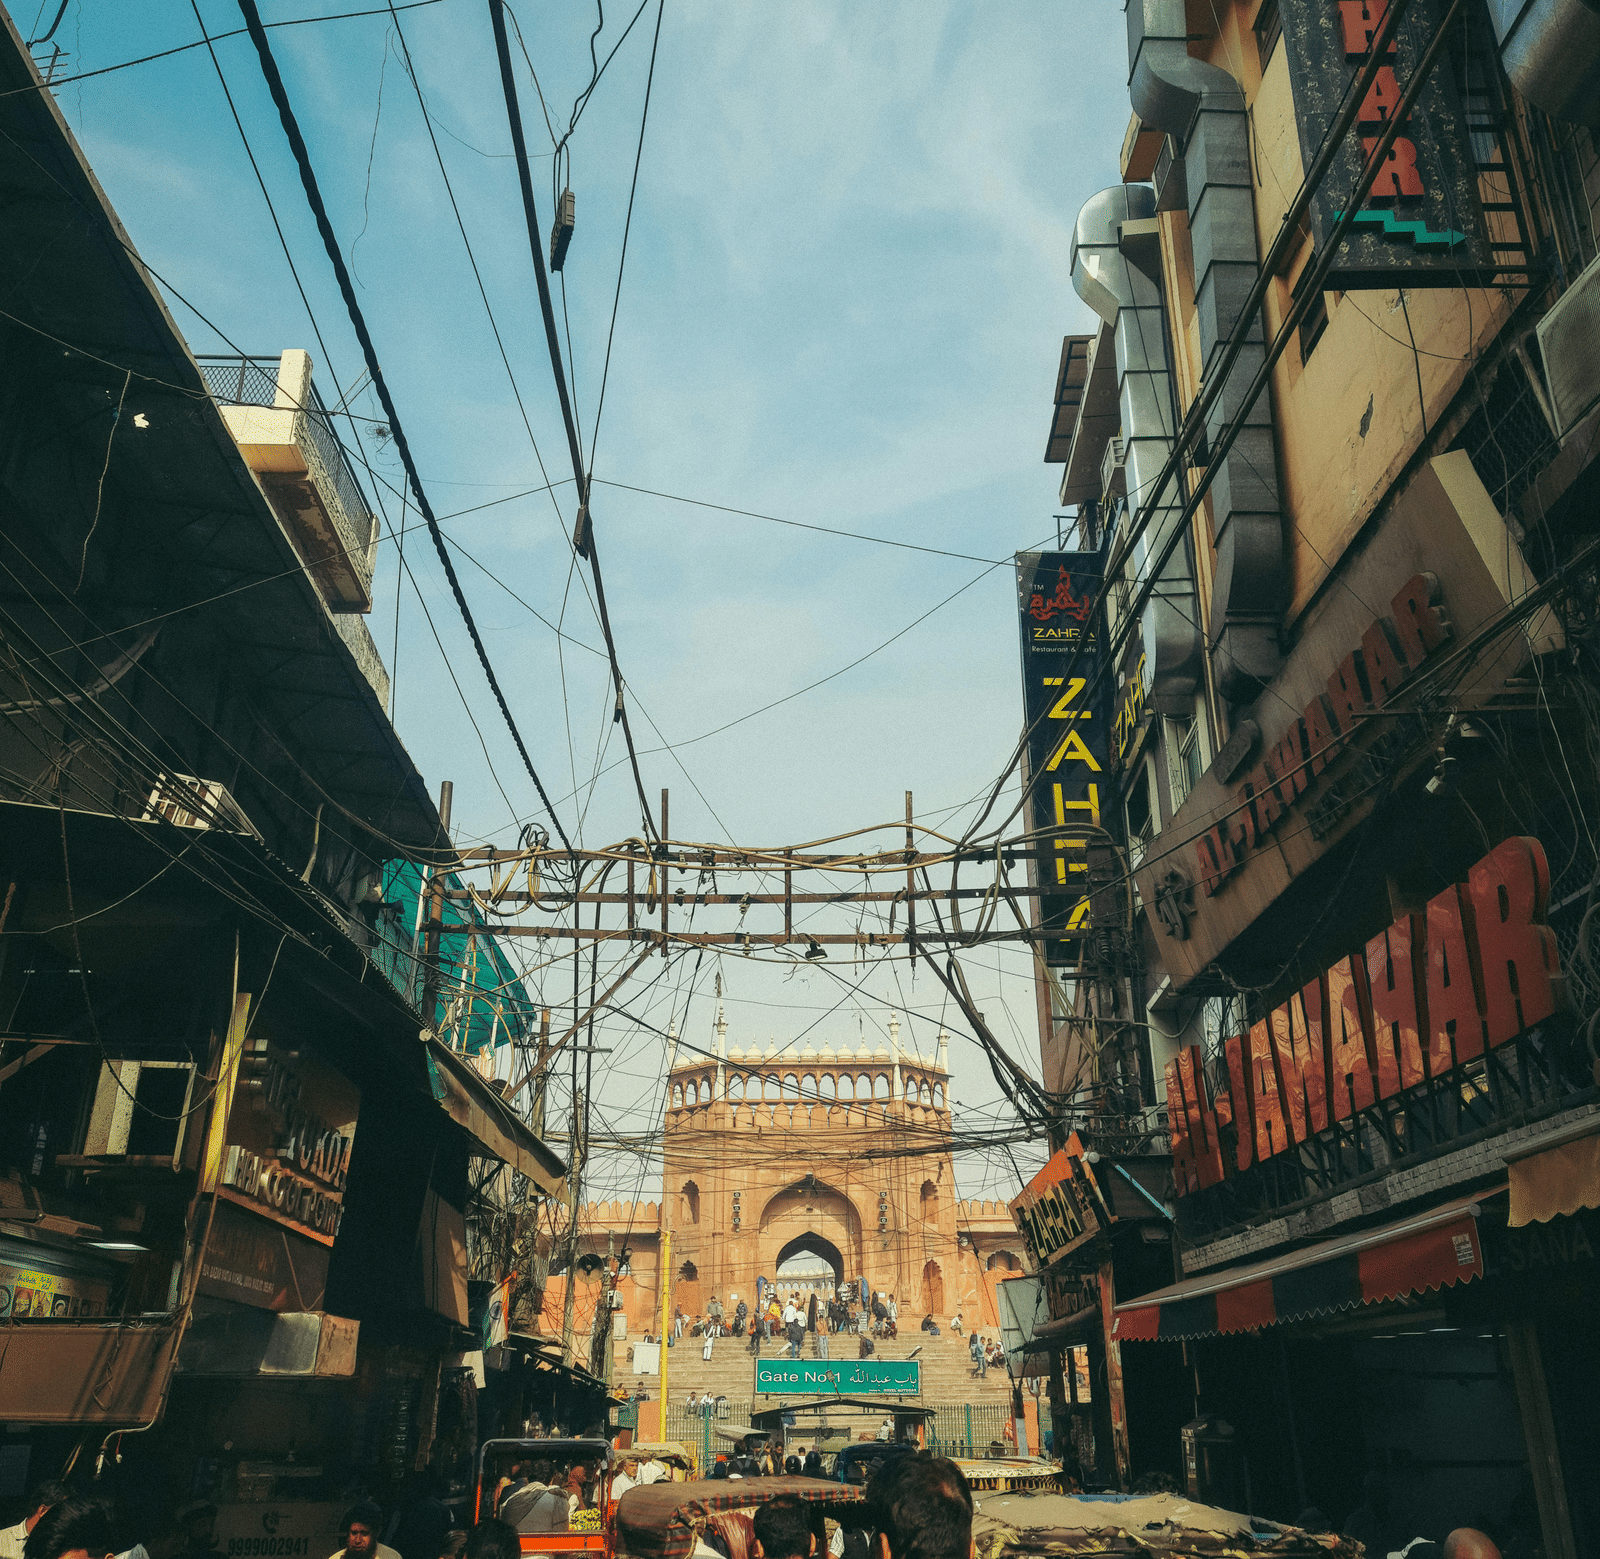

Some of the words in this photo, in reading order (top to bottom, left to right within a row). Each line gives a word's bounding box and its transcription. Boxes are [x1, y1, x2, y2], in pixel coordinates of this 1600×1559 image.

[1033, 627, 1095, 639] ZAHR
[1031, 645, 1069, 653] Restaurant
[1195, 572, 1440, 899] AL-JAWAHAR
[1163, 835, 1559, 1199] AL-JAWAHAR
[1024, 1183, 1083, 1260] ZAHRA
[759, 1370, 799, 1382] Gate
[894, 1373, 918, 1387] باب
